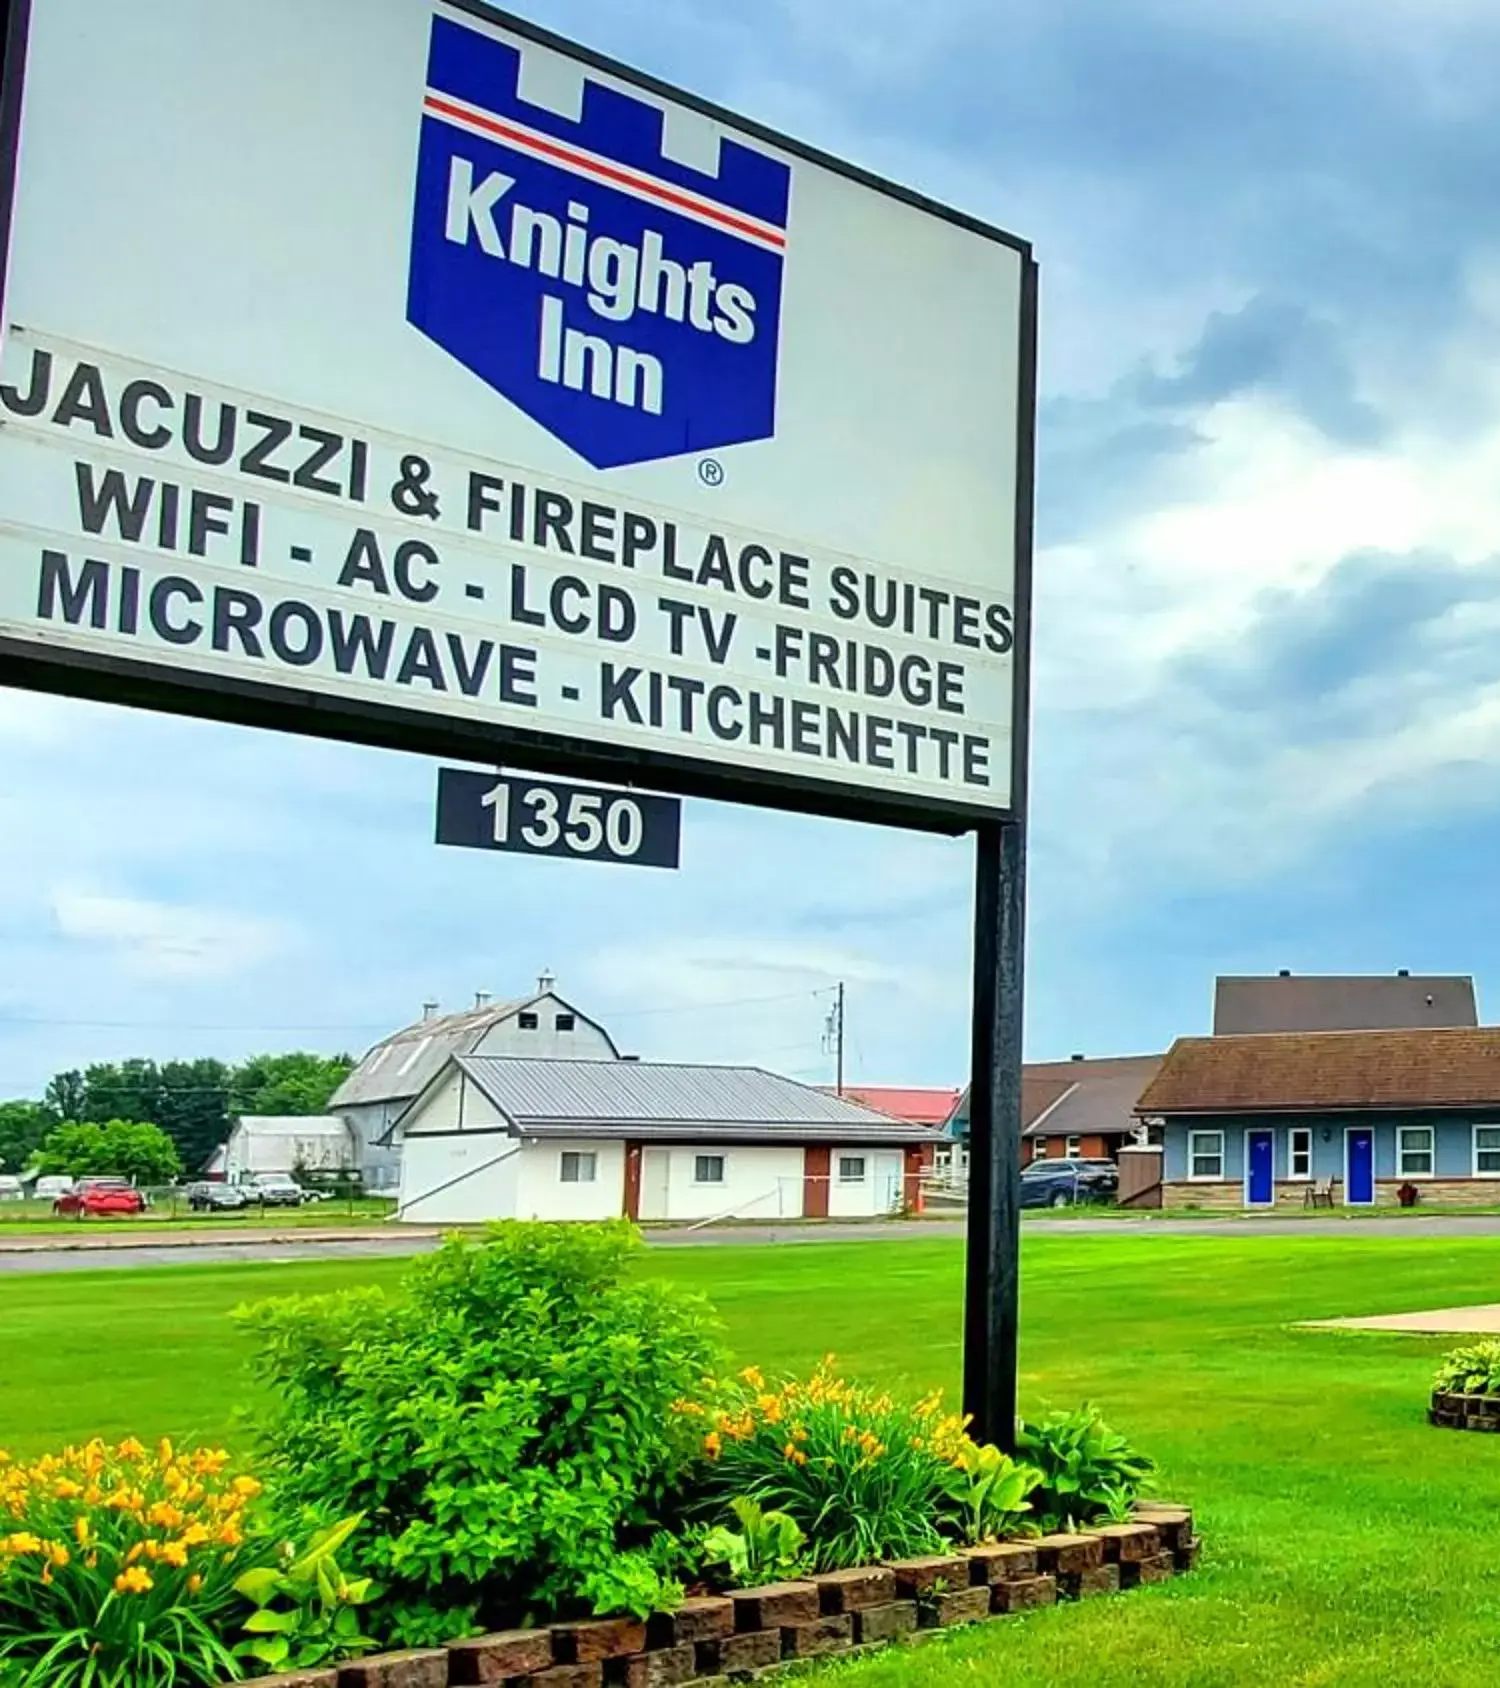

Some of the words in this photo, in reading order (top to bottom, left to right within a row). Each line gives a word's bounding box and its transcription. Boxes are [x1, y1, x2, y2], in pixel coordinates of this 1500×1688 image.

[446, 156, 757, 345] Knights
[539, 294, 664, 415] Inn
[0, 349, 367, 502] JACUZZI
[391, 454, 441, 521] &
[467, 471, 809, 610] FIREPLACE
[829, 566, 1014, 652] SUITES
[75, 461, 259, 567] WIFI
[336, 528, 440, 603] AC
[511, 563, 637, 642] LCD
[658, 597, 737, 664] TV
[37, 549, 537, 707] MICROWAVE
[601, 662, 990, 787] KITCHENETTE
[481, 783, 643, 857] 1350
